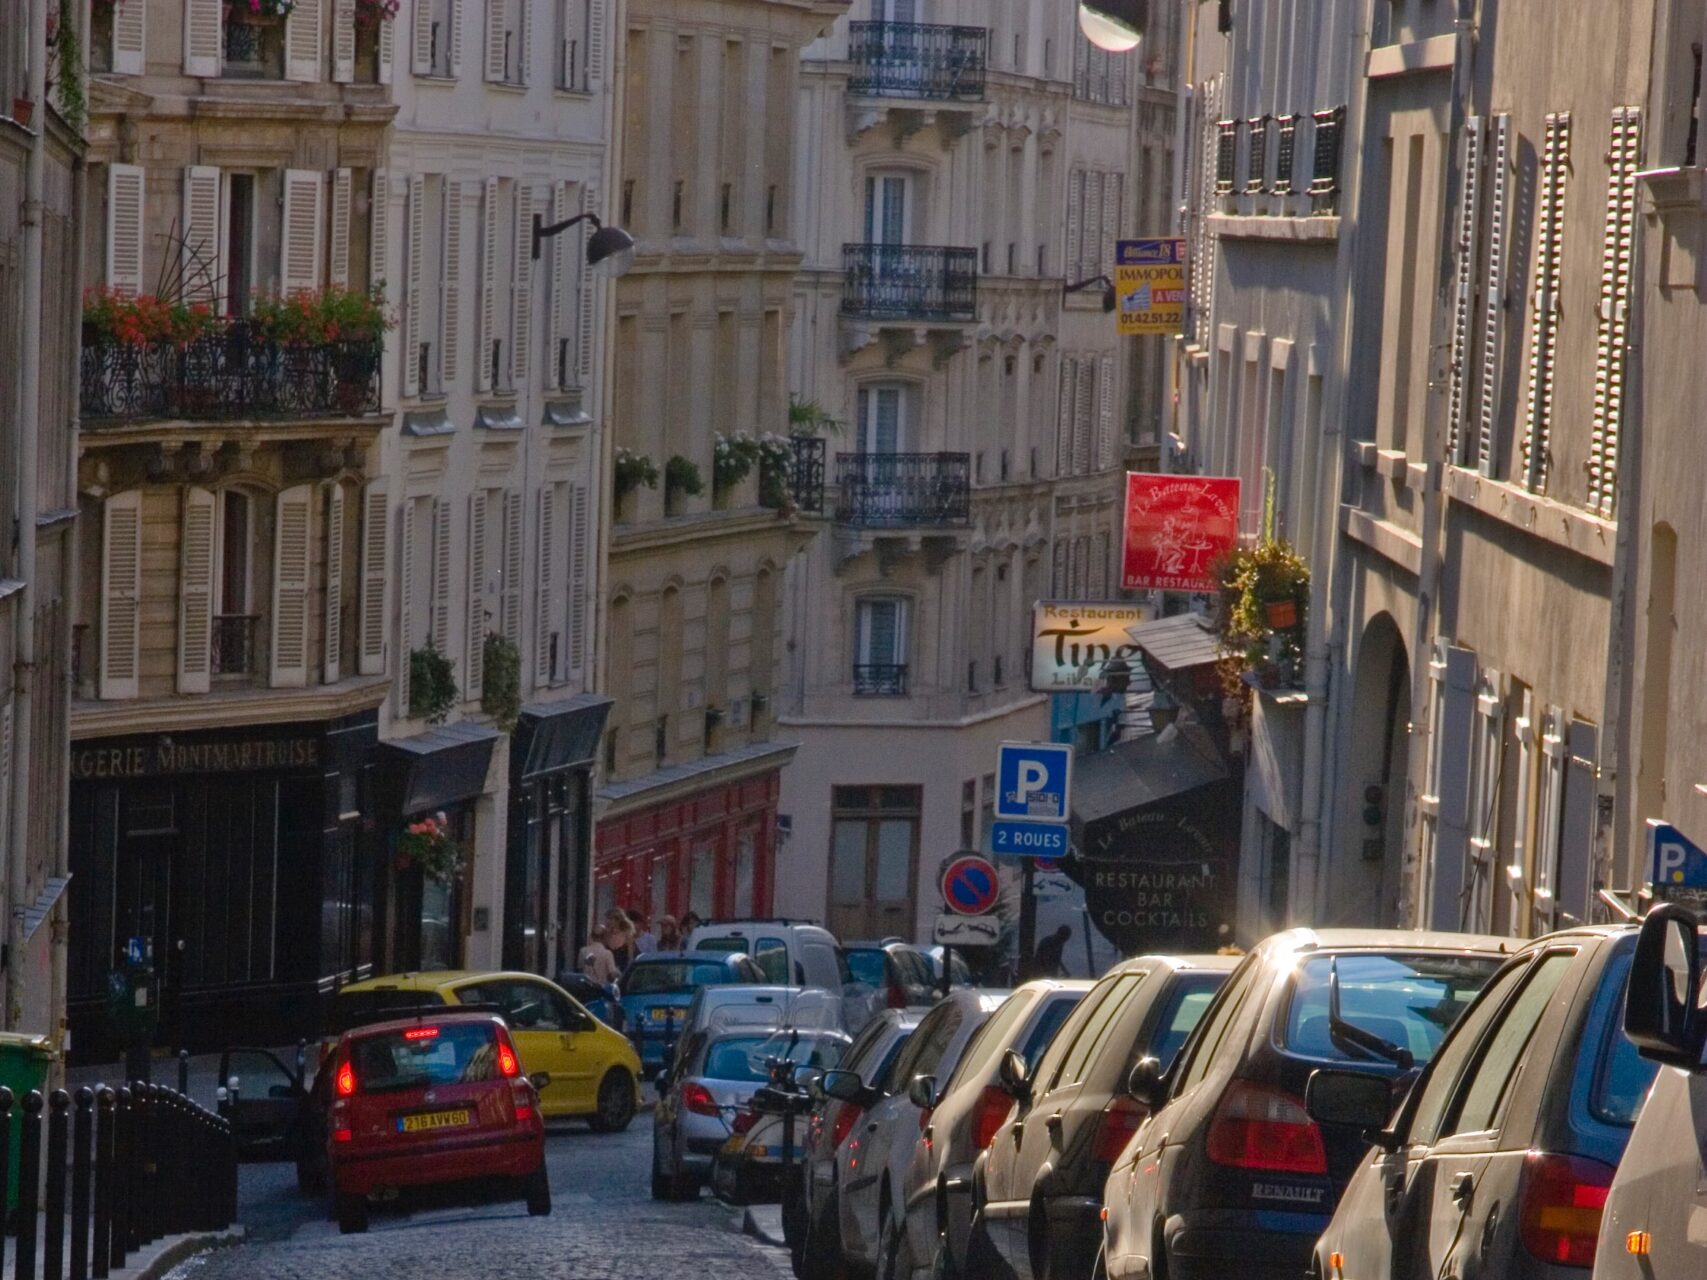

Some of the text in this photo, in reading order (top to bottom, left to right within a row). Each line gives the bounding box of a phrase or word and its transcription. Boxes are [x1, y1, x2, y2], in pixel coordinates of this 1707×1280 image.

[1127, 575, 1150, 586] BAR
[1044, 604, 1142, 619] Restaurant
[1017, 760, 1048, 804] P
[998, 831, 1061, 847] 2 ROUES
[1096, 872, 1216, 889] RESTAURANT
[1138, 892, 1173, 907] BAR
[1103, 911, 1208, 927] COCKTAILS
[1252, 1183, 1325, 1203] RENAULT
